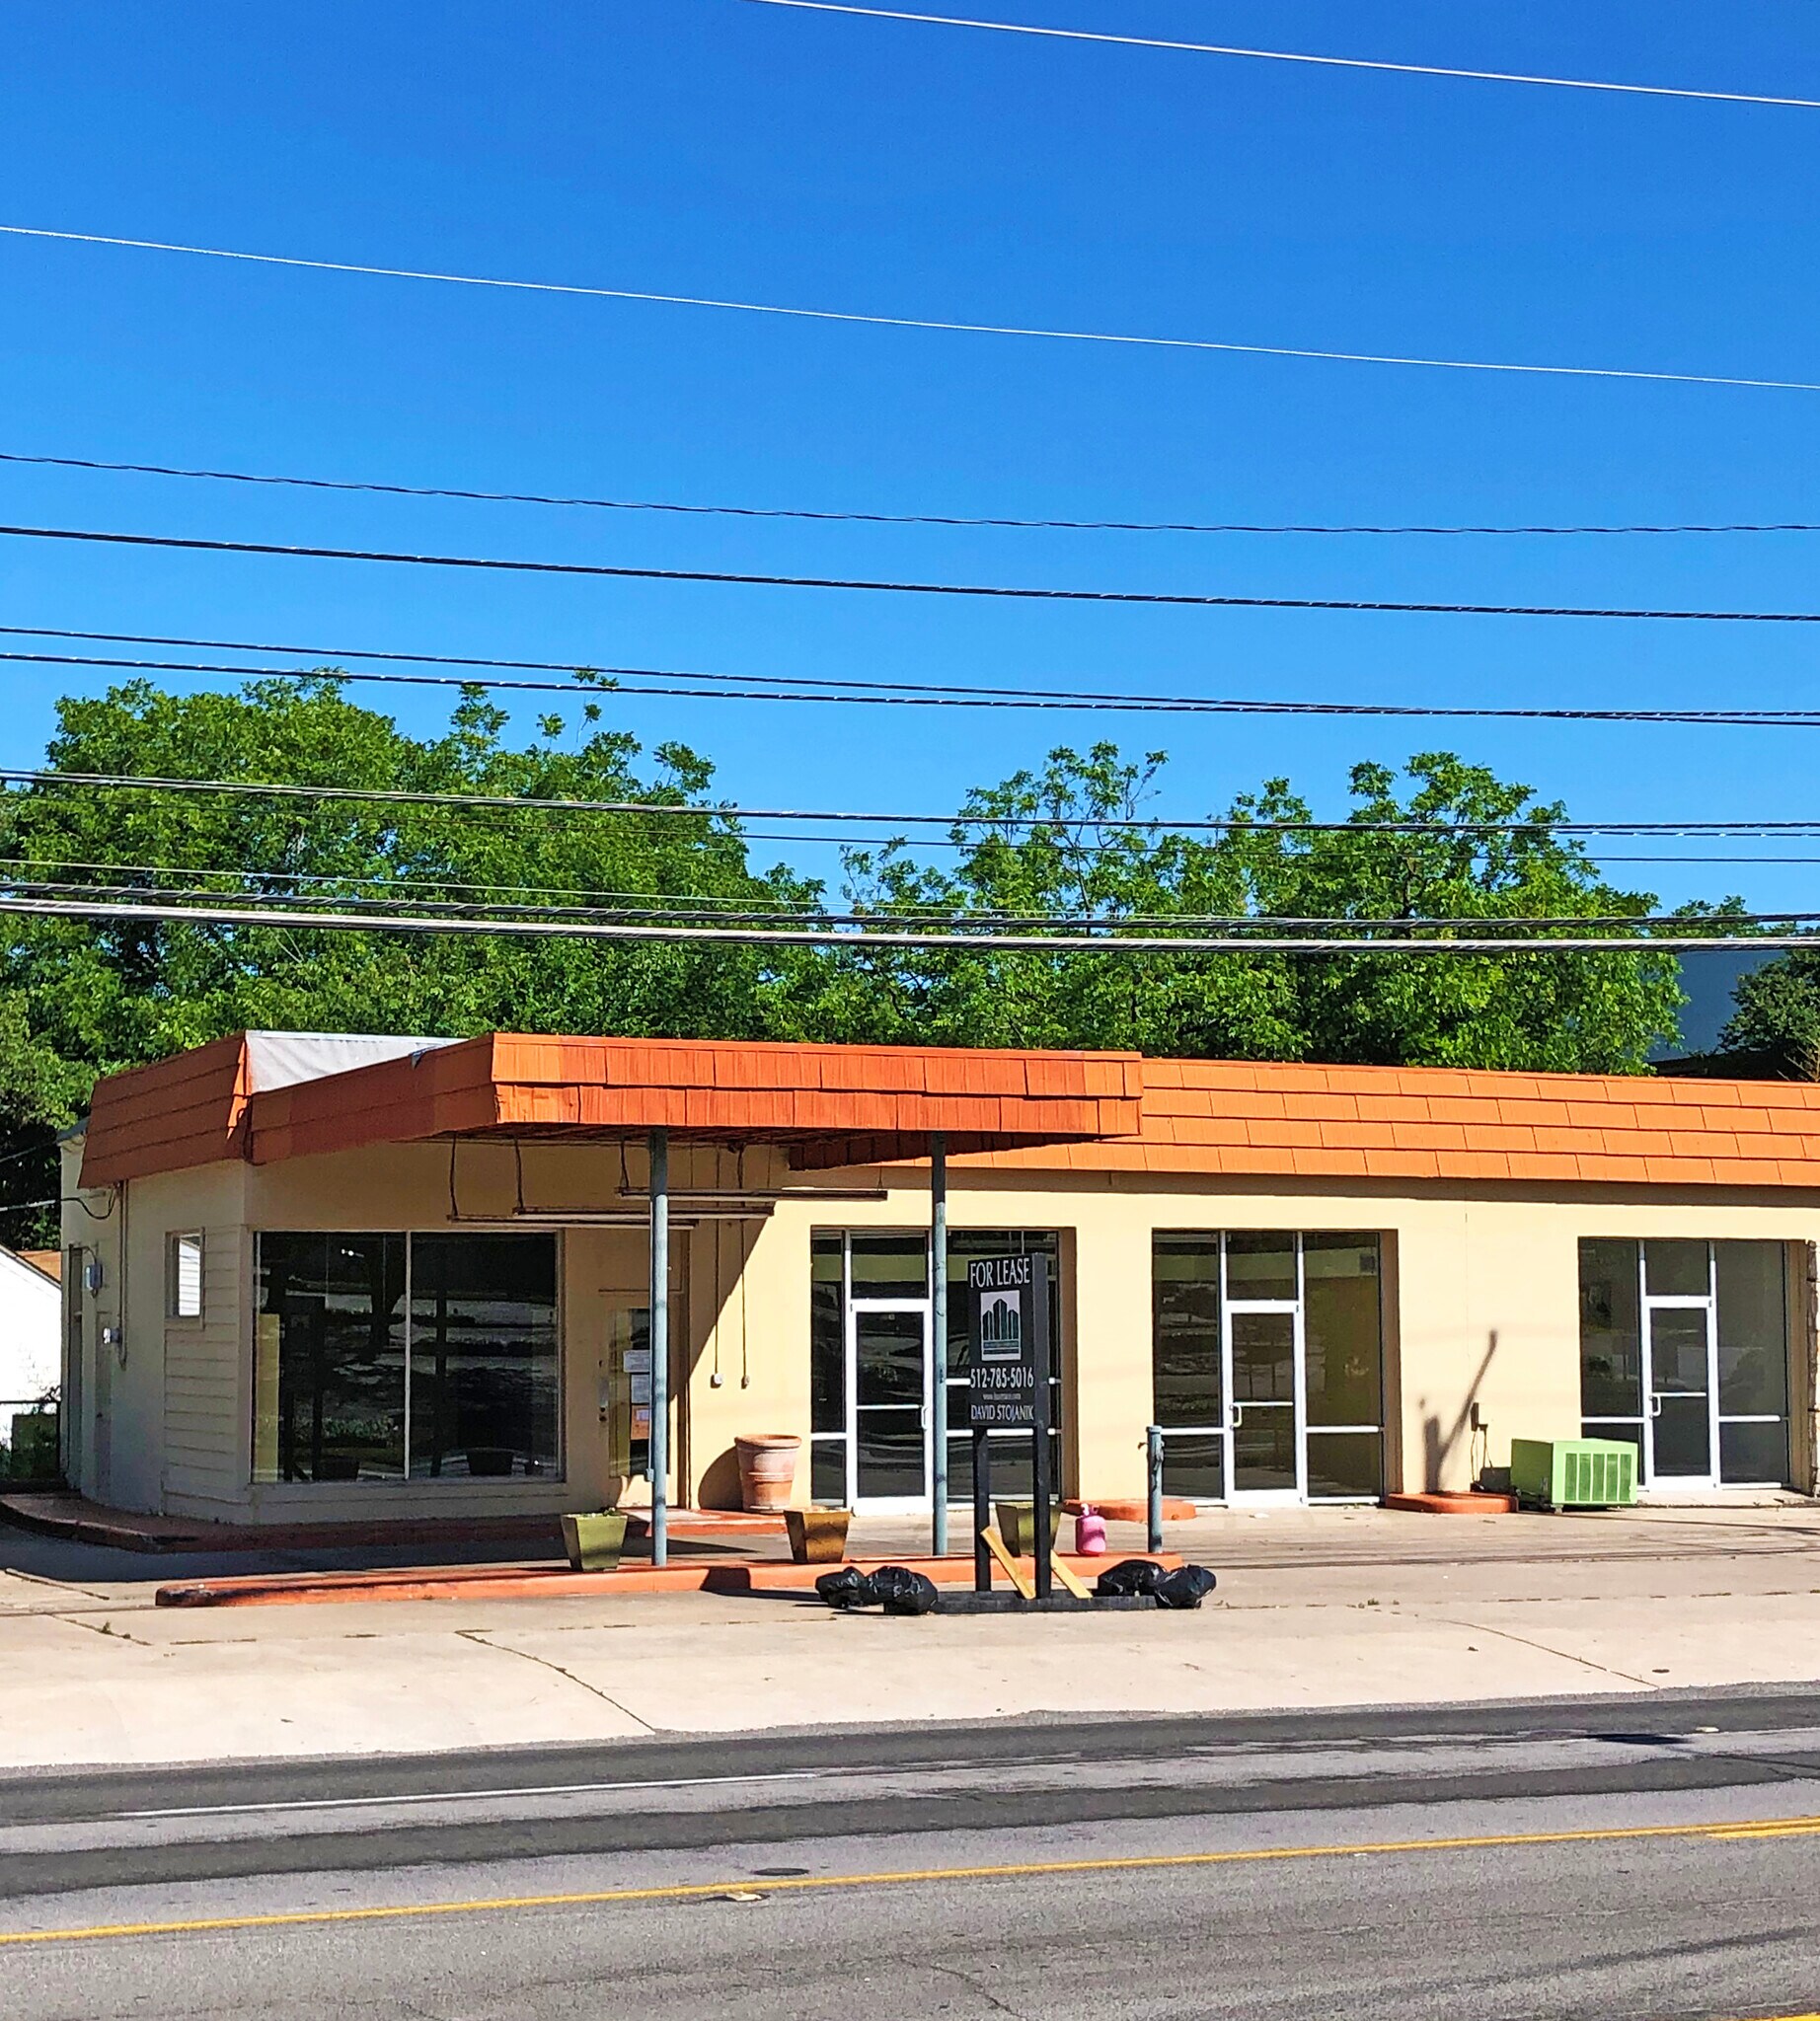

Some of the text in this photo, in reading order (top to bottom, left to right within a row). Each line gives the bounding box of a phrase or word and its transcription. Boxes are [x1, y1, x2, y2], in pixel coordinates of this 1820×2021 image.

[970, 1257, 1030, 1288] FOR LEASE
[970, 1366, 1033, 1388] 512-785-5016
[970, 1404, 995, 1421] DAVID
